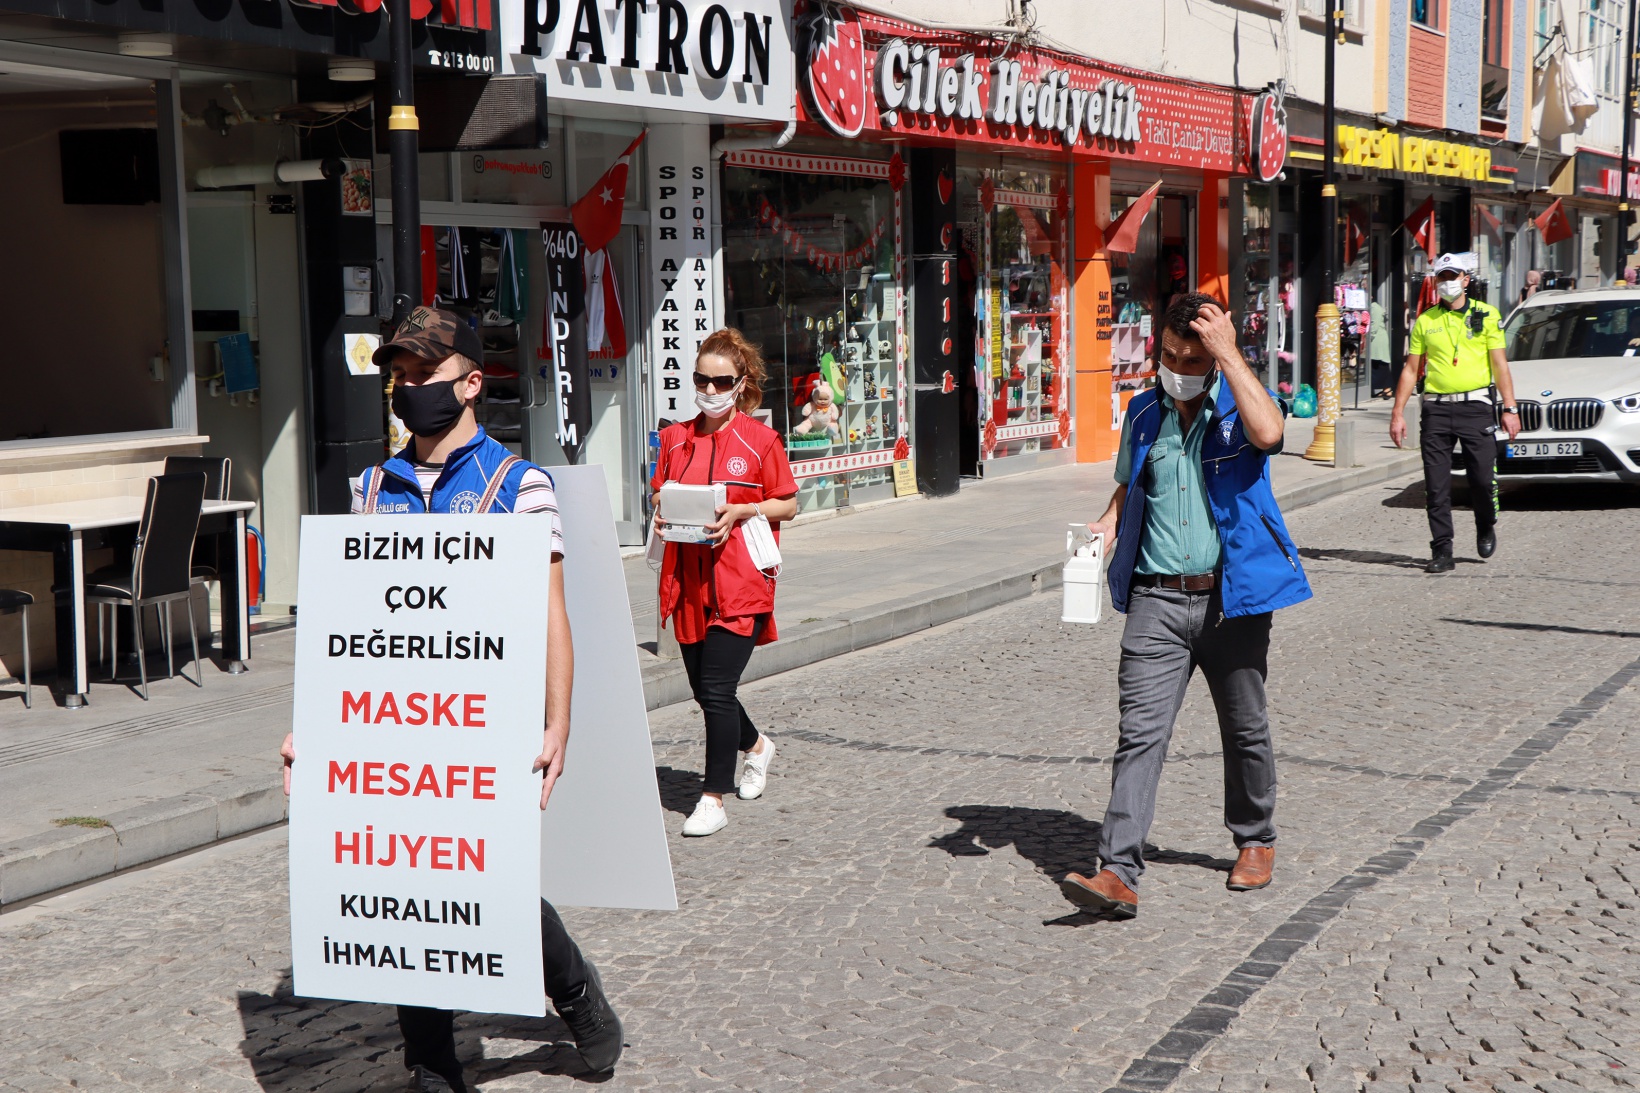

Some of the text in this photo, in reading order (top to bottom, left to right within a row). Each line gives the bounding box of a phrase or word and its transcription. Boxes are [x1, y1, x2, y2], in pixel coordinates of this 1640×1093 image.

[443, 51, 494, 72] 213 00 01
[521, 0, 772, 85] PATRON
[880, 38, 1142, 146] Çilek Hediyelik
[692, 166, 706, 240] SPOR
[542, 229, 578, 259] %40
[659, 166, 681, 410] SPOR AYAKKABI
[1513, 443, 1579, 456] 29 AD 622
[344, 531, 495, 565] BİZİM İÇİN
[384, 585, 448, 614] ÇOK
[328, 628, 504, 660] DEĞERLİSİN
[341, 690, 487, 728] MASKE
[328, 760, 497, 800] MESAFE
[335, 825, 485, 872] HİJYEN
[340, 893, 481, 927] KURALINI
[323, 935, 504, 978] İHMAL ETME
